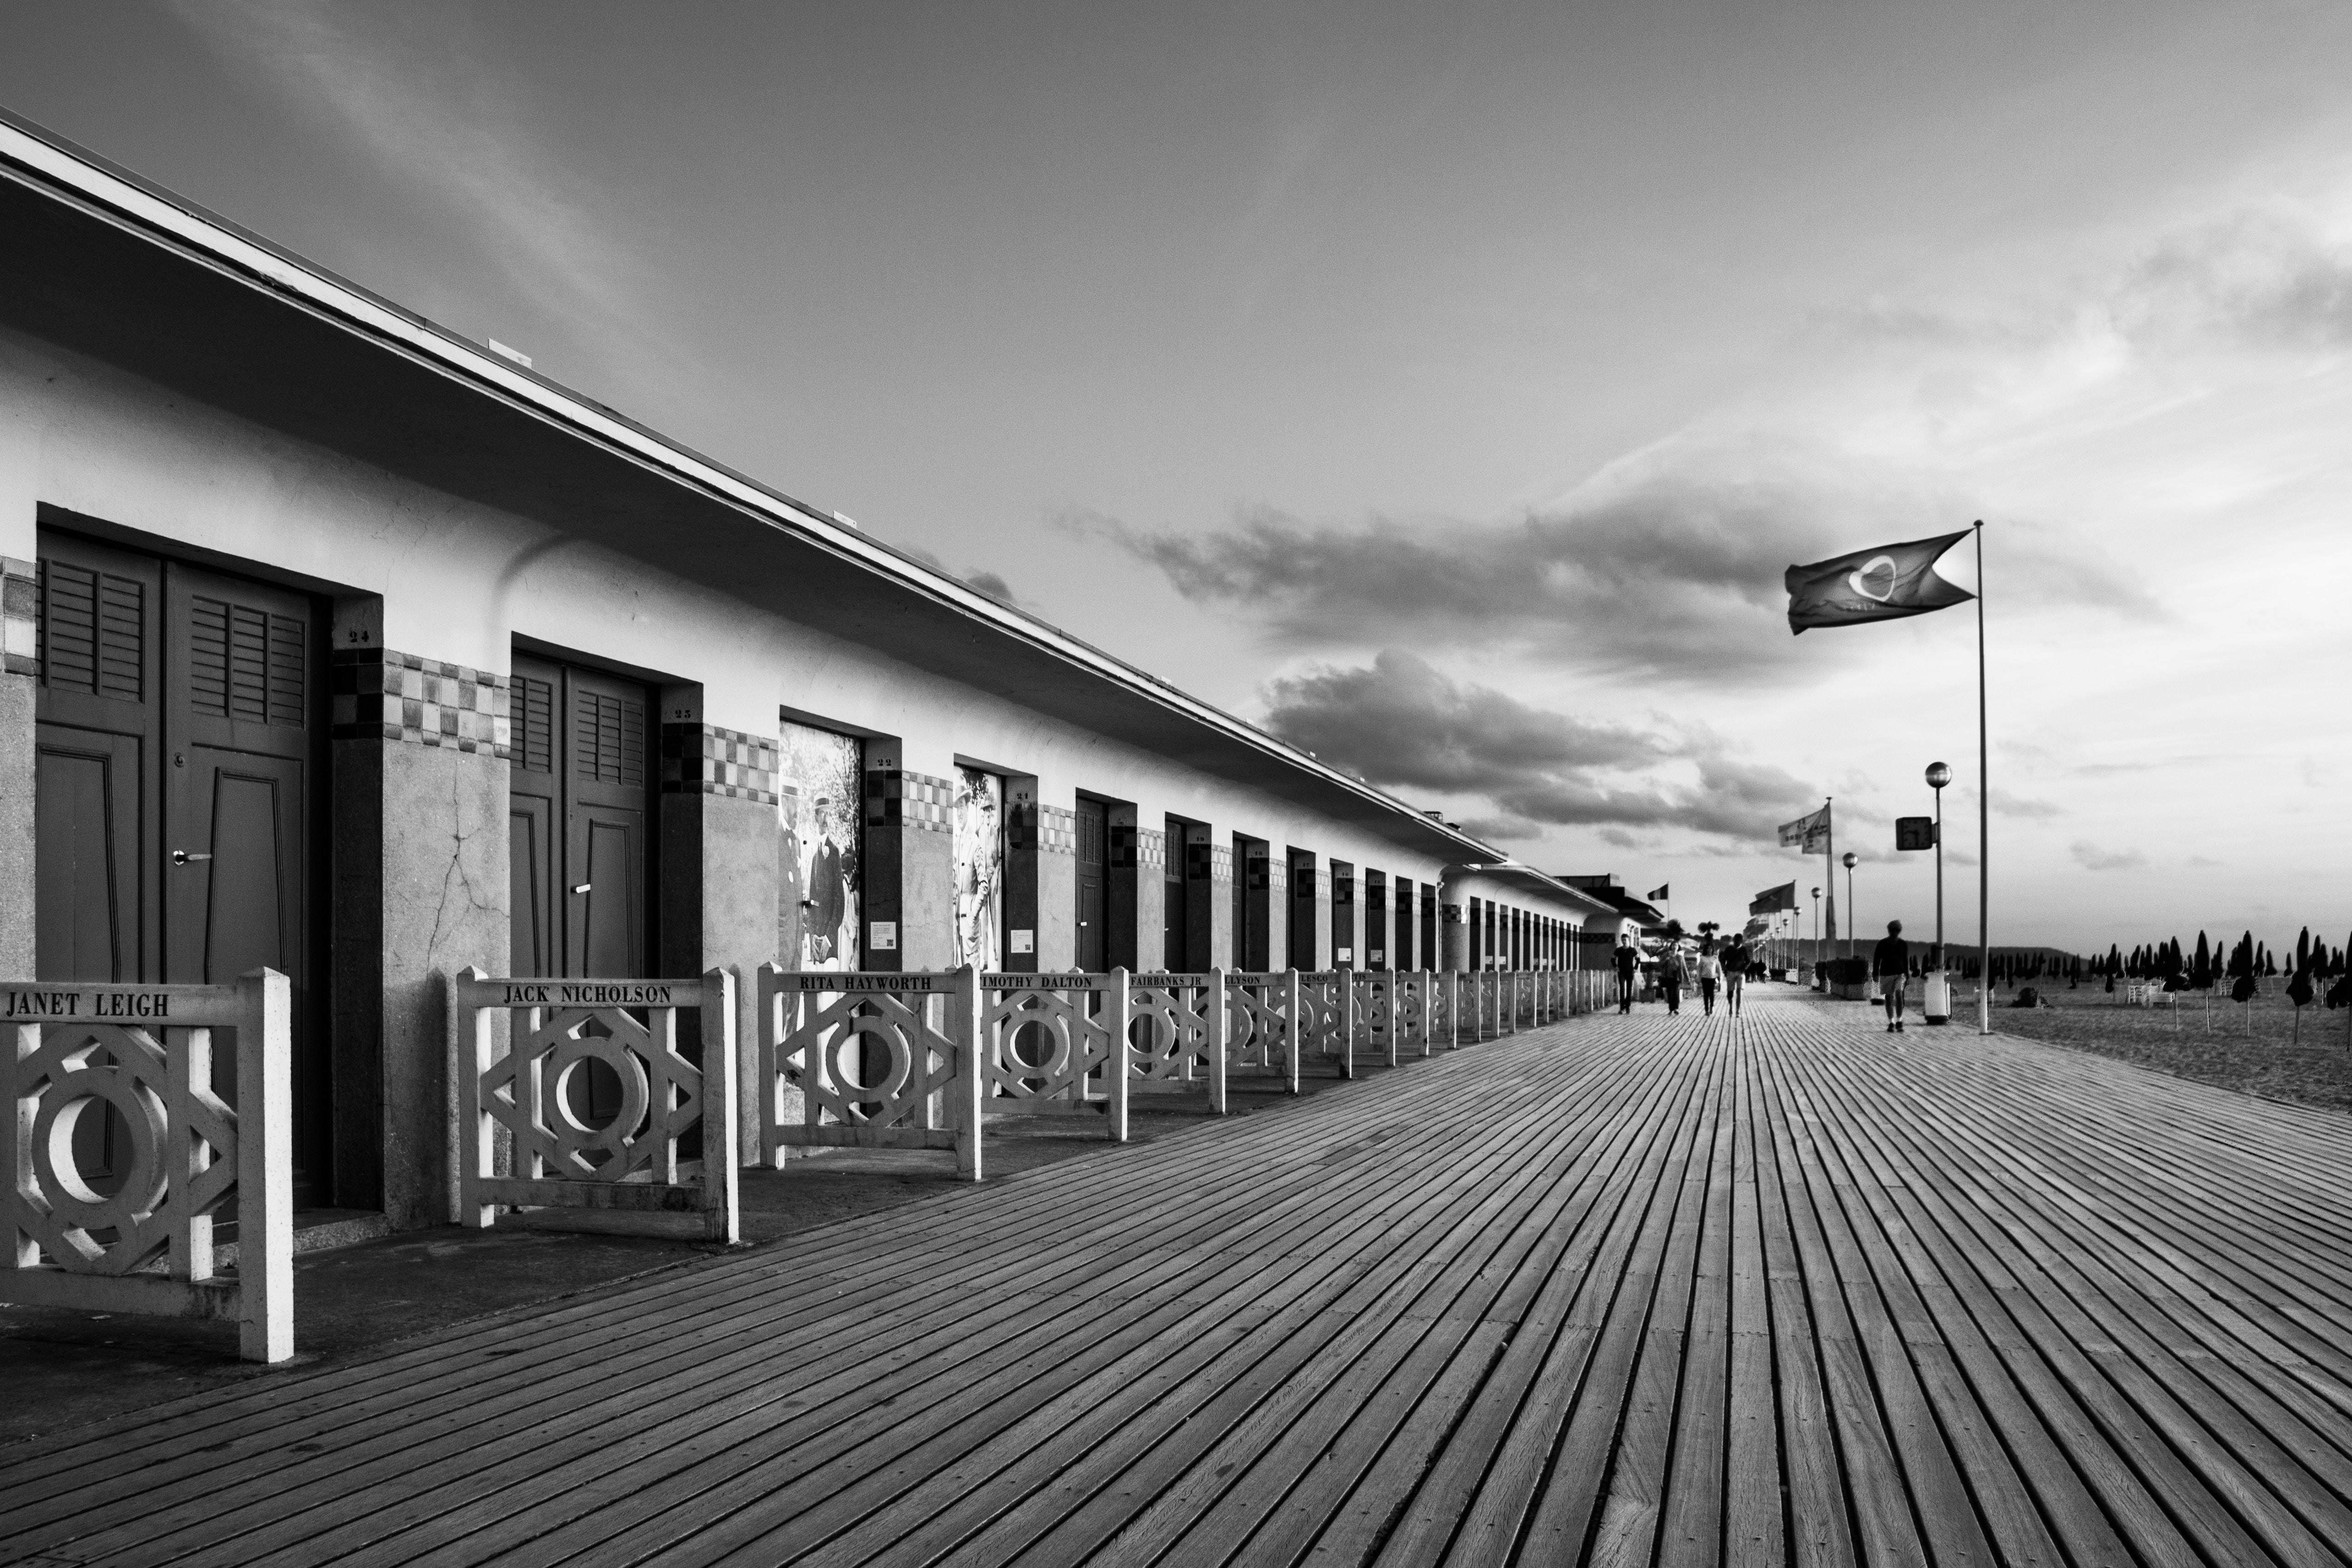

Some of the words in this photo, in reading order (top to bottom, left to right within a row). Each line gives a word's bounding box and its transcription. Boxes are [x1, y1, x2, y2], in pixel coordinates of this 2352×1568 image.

[349, 630, 369, 643] 24
[800, 977, 835, 989] RITA
[845, 977, 931, 990] HAYWORTH
[1041, 977, 1092, 988] DALTON
[1131, 976, 1184, 986] FAIRBANKS
[1190, 976, 1201, 986] JR
[1224, 976, 1260, 984] LLYSON
[504, 986, 550, 1004] JACK
[561, 986, 671, 1003] NICHOLSON
[6, 992, 80, 1017] JANET
[95, 993, 169, 1017] LEIGH
